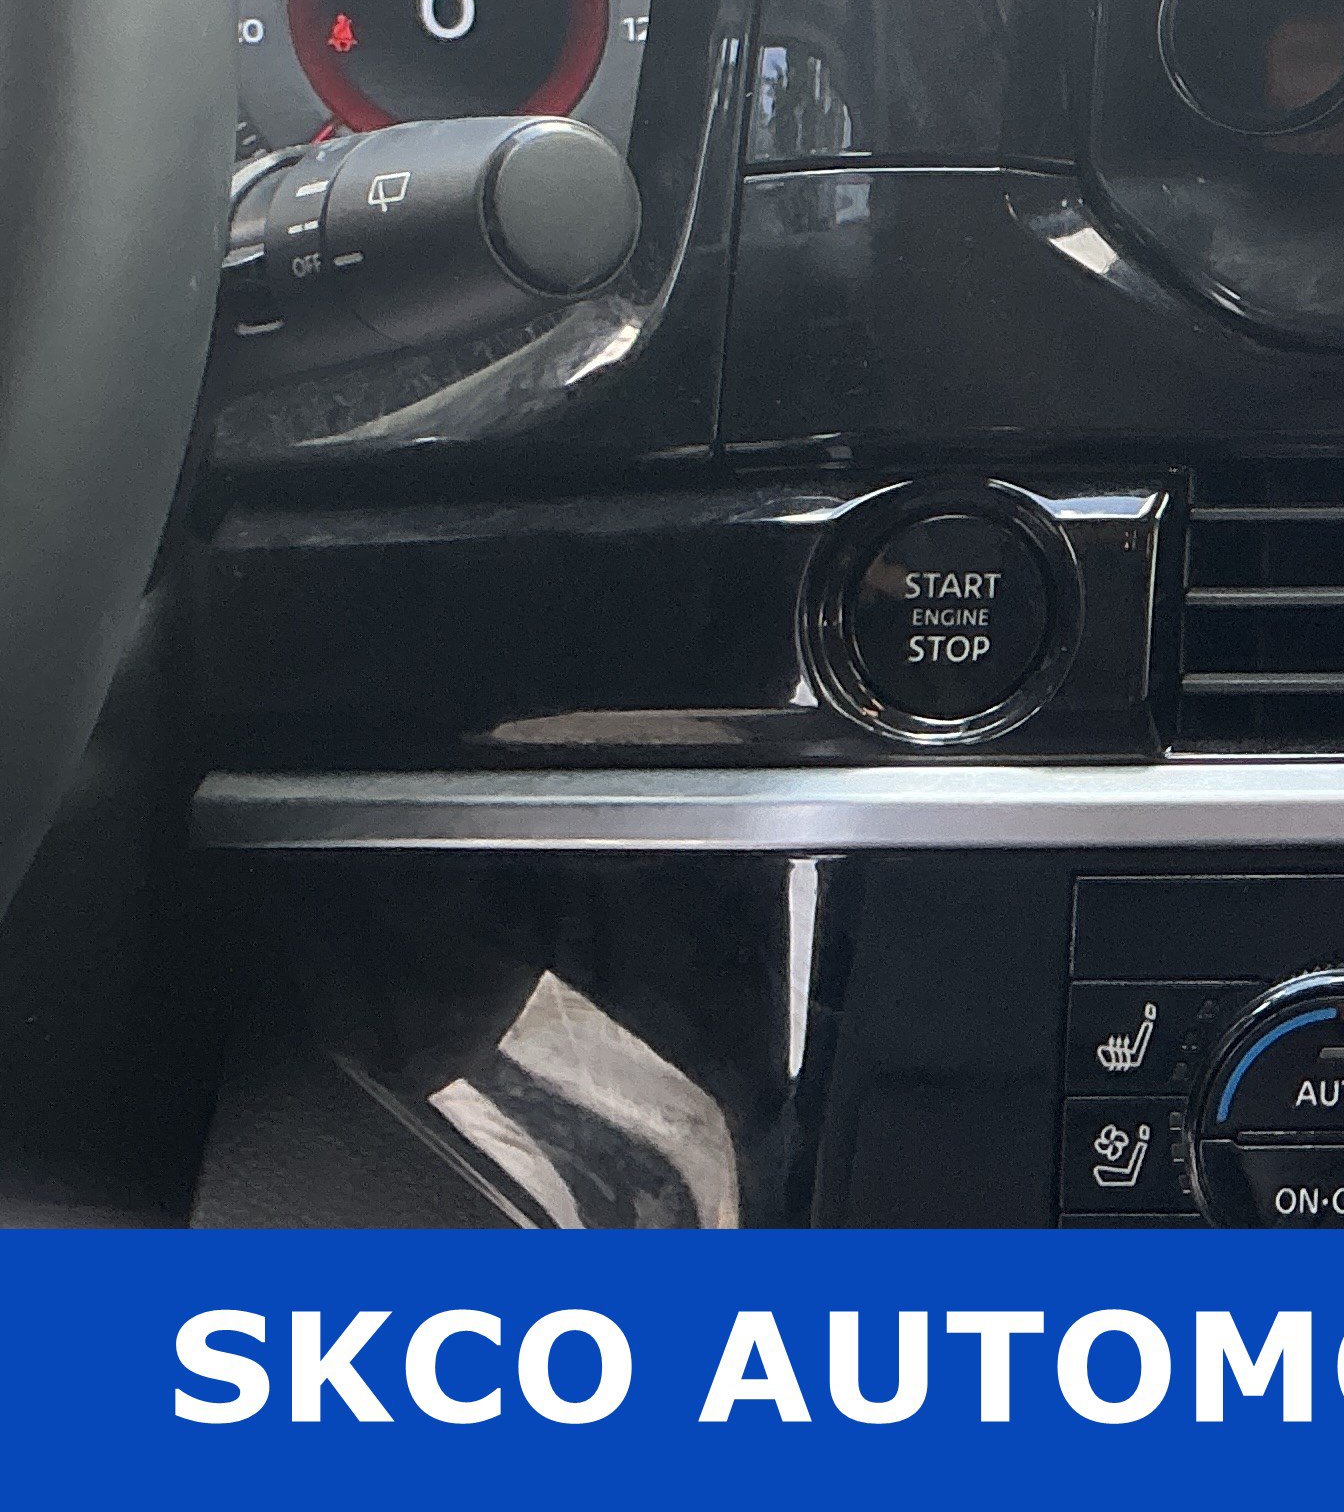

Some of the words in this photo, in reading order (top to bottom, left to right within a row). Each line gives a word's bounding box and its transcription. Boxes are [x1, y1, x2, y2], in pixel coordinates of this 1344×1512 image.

[237, 17, 266, 45] 0
[904, 571, 1002, 600] START
[911, 607, 990, 627] ENGINE
[907, 635, 991, 663] STOP
